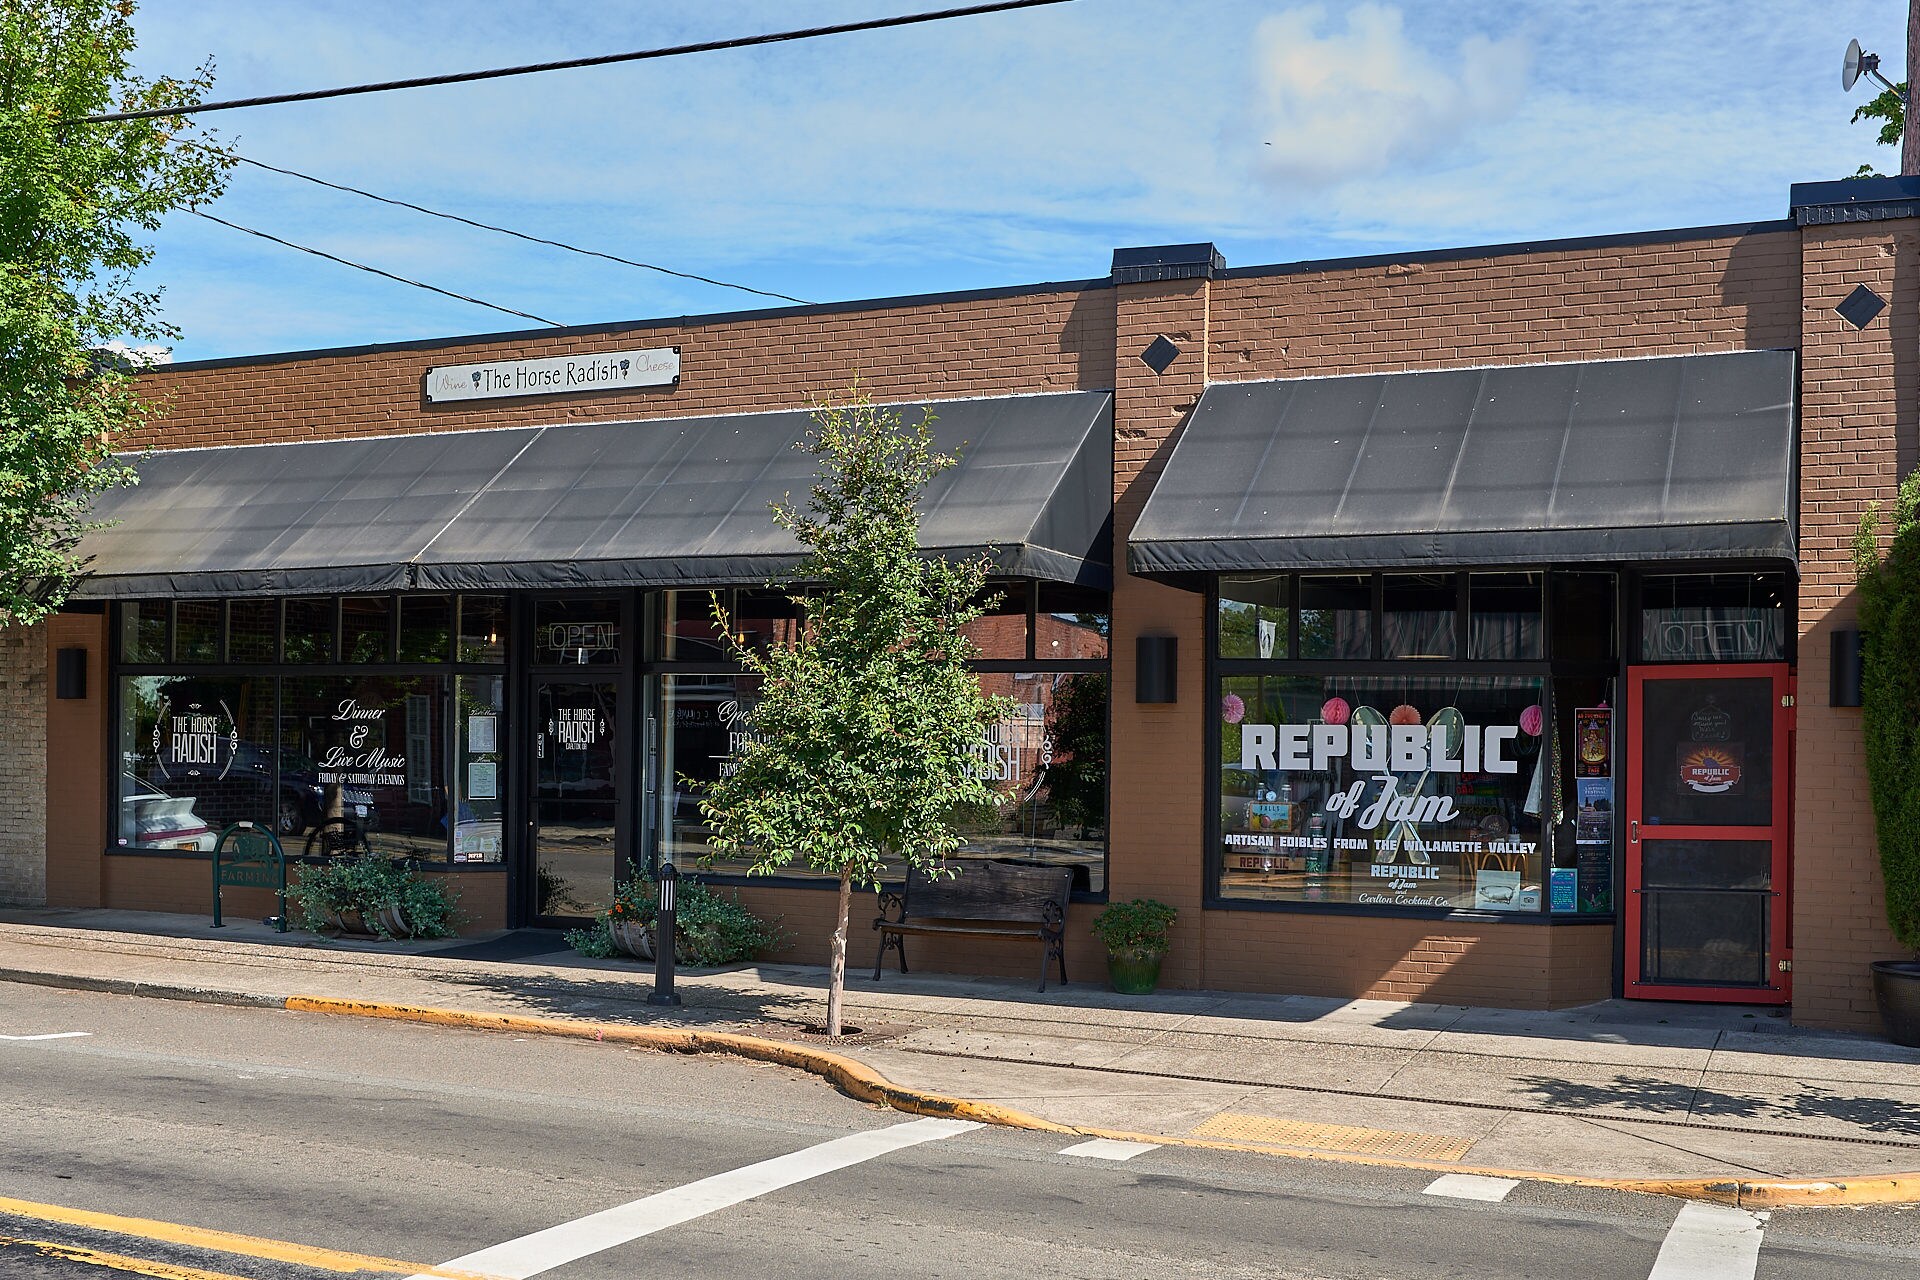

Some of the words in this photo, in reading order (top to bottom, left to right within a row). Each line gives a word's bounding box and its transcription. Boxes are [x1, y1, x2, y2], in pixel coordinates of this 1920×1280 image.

[435, 374, 468, 394] Wine
[483, 368, 511, 392] The
[516, 366, 561, 390] Horse
[566, 358, 618, 386] Radish
[635, 354, 675, 373] Cheese
[552, 625, 612, 648] OPEN
[1664, 622, 1758, 653] OPEN
[331, 698, 386, 721] Dinner
[558, 708, 571, 721] THE
[573, 708, 596, 721] HORSE
[717, 700, 752, 730] Ope
[172, 716, 188, 733] THE
[191, 716, 218, 734] HORSE
[558, 721, 595, 744] RADISH
[171, 733, 217, 764] RADISH
[349, 725, 369, 749] &
[317, 746, 354, 768] Live
[355, 747, 406, 773] Music
[1241, 724, 1518, 774] REPUBLIC
[954, 744, 1020, 781] ADISH
[1692, 768, 1730, 776] REPUBLIC
[318, 772, 338, 784] FRIDAY
[338, 773, 347, 784] &
[347, 773, 377, 785] SATURDAY
[377, 774, 405, 786] EVENINGS
[1325, 780, 1366, 820] of
[1358, 775, 1460, 830] Jam
[1224, 833, 1274, 847] ARTISAN
[1279, 836, 1328, 849] EDIBLES
[1333, 837, 1368, 850] FROM
[1374, 839, 1398, 851] THE
[1403, 840, 1482, 853] WILLAMETTE
[1488, 842, 1537, 854] VALLEY
[220, 869, 280, 885] FARMING
[1370, 864, 1440, 880] REPUBLIC
[1388, 879, 1400, 890] of
[1398, 878, 1418, 890] Jam
[1358, 892, 1393, 905] Carlton
[1394, 894, 1433, 906] Cocktail
[1433, 896, 1452, 907] Co.
